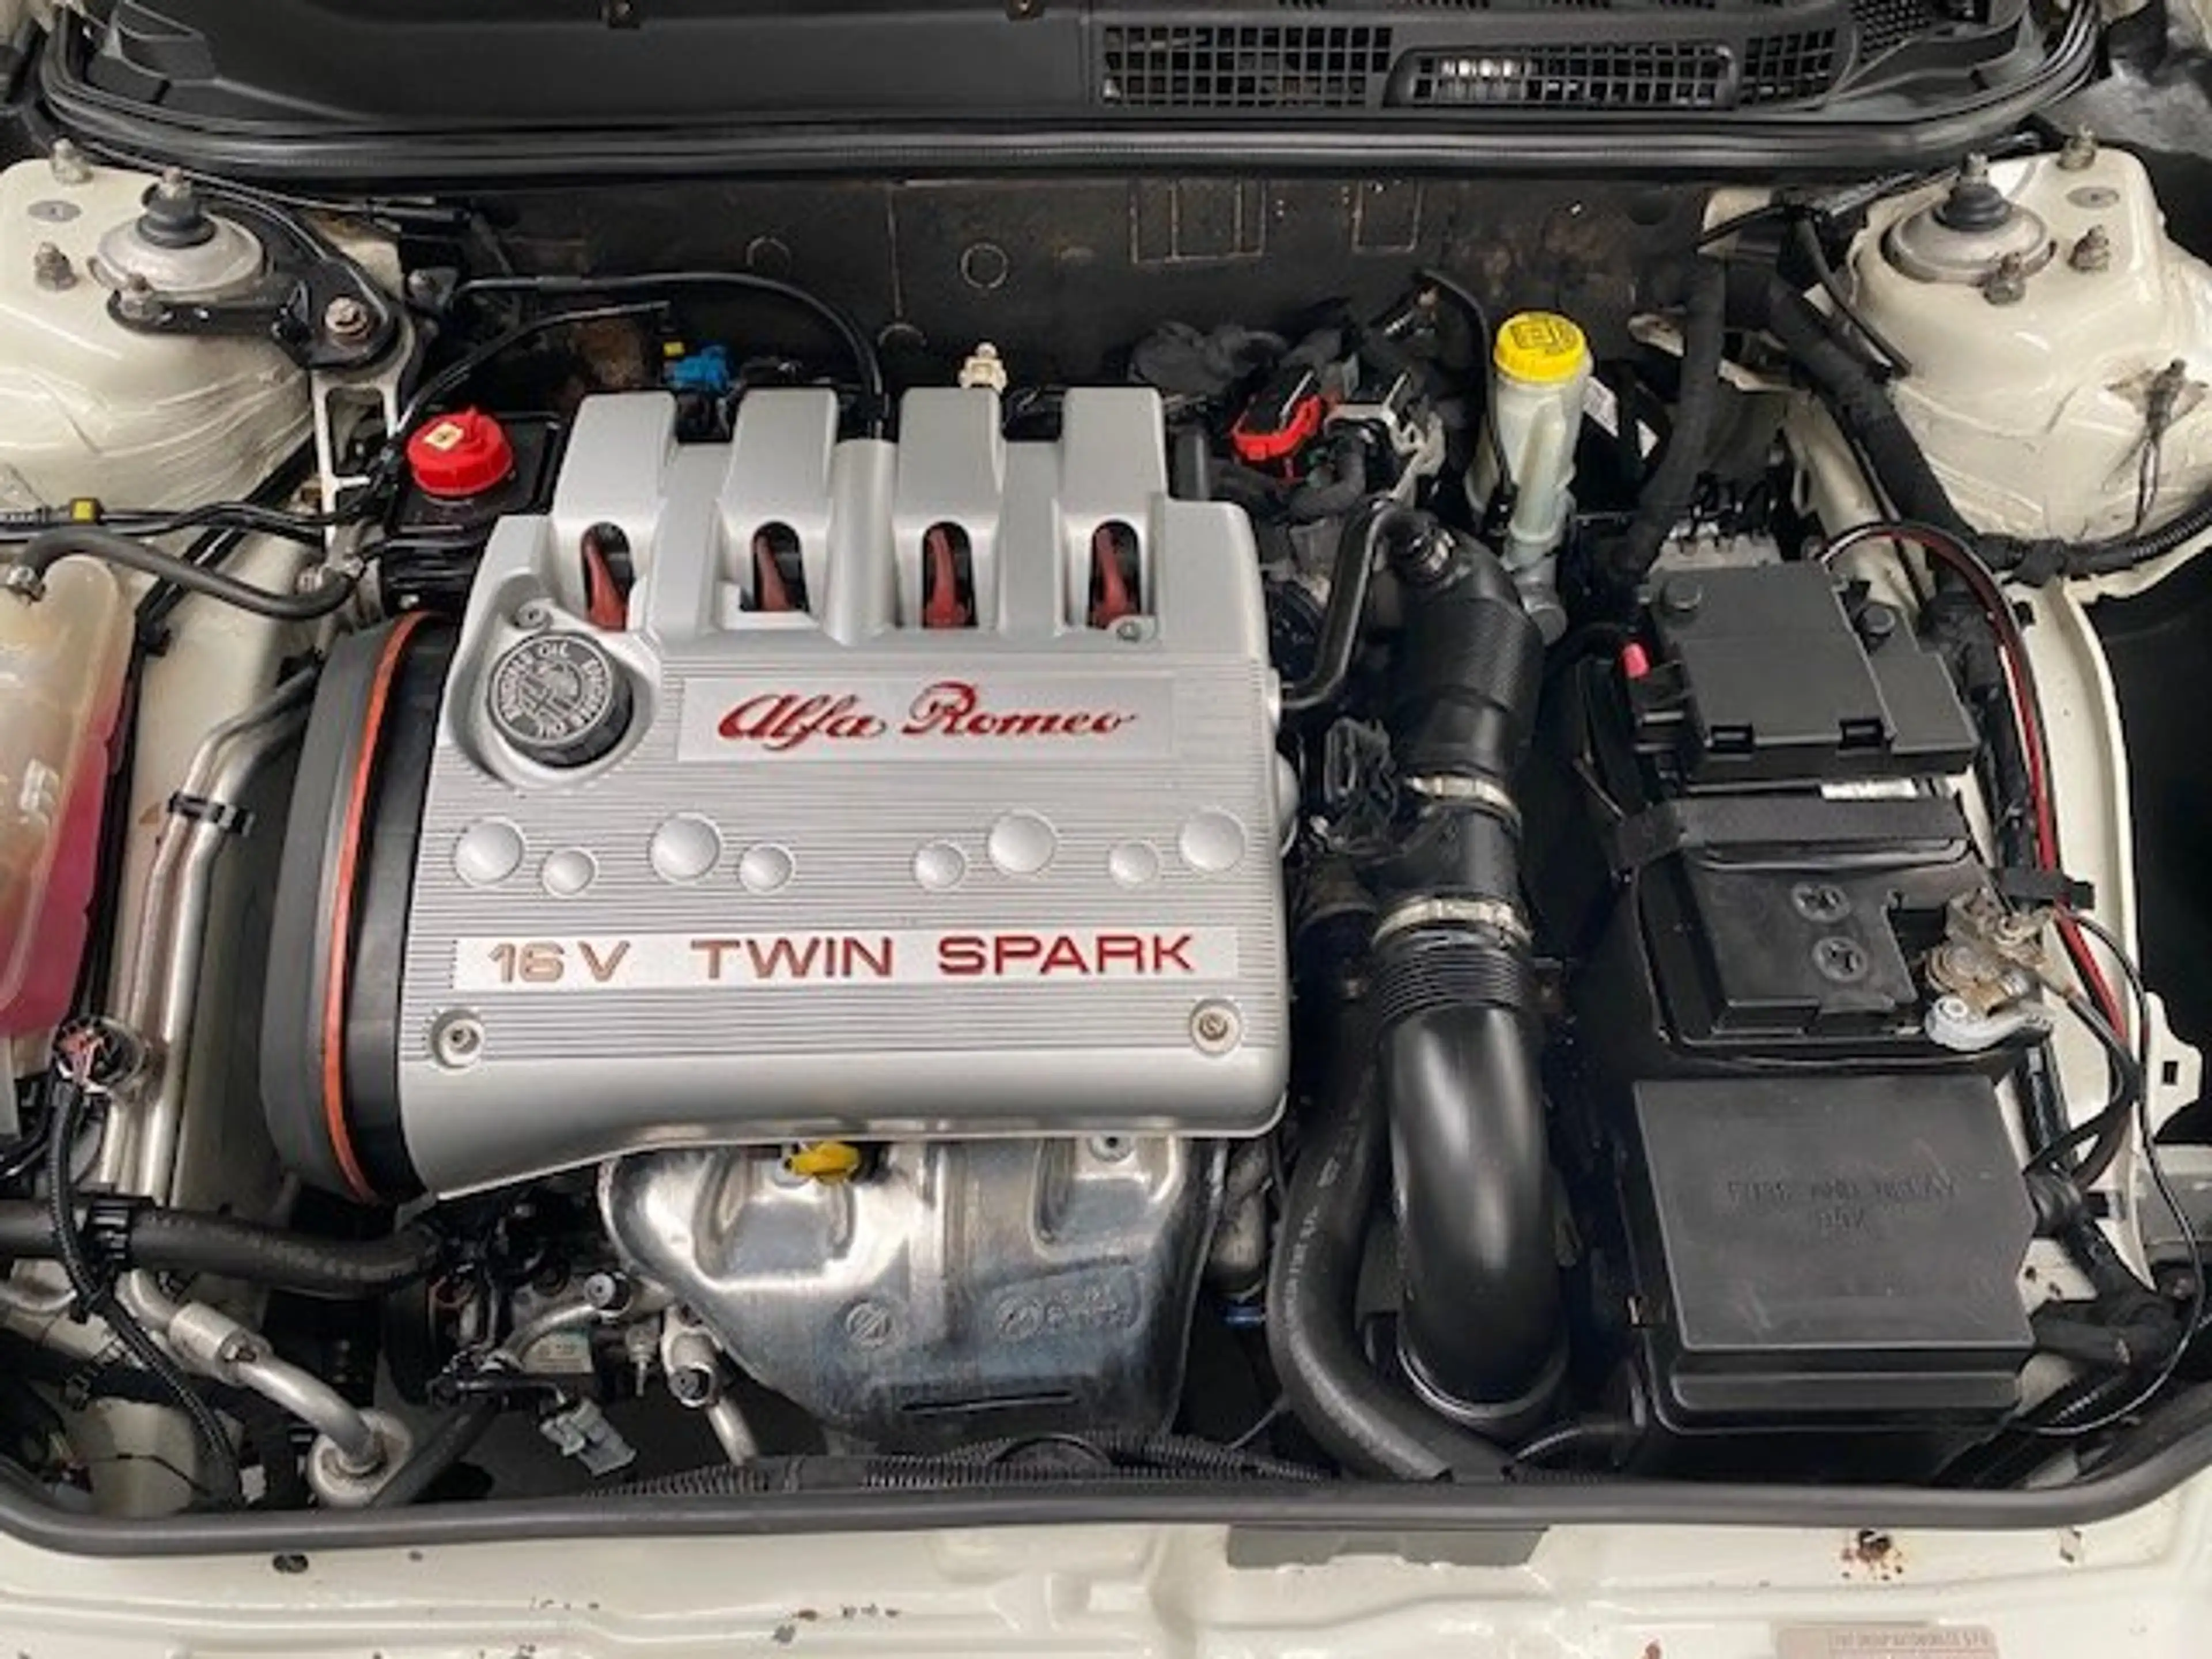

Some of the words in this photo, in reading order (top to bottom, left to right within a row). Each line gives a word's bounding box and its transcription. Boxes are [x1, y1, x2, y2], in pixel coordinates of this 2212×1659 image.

[537, 641, 570, 659] OIL
[717, 694, 888, 751] Alfa
[902, 682, 1138, 735] Romeo
[691, 935, 893, 979] TWIN
[938, 934, 1195, 976] SPARK
